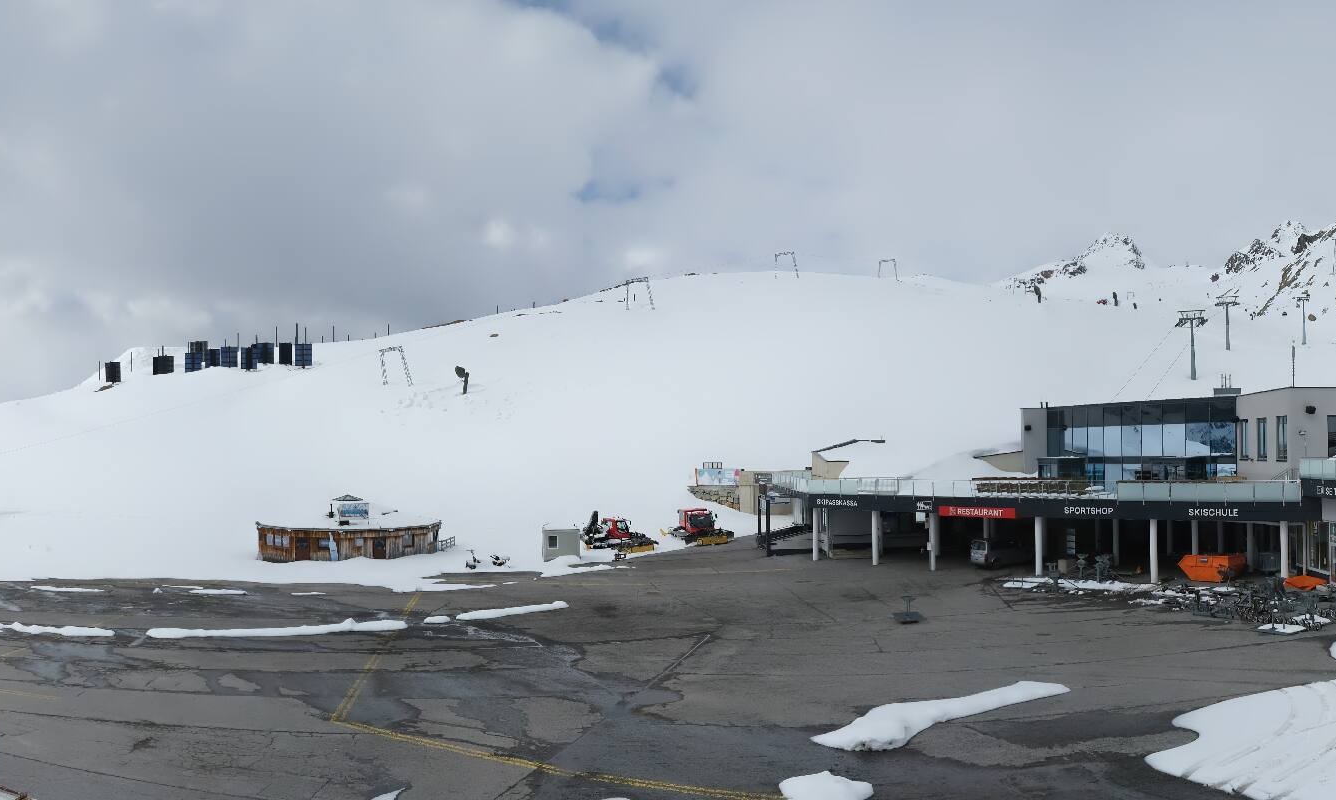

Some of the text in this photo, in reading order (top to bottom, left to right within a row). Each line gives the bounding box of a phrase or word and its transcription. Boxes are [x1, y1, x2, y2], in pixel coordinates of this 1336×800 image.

[957, 508, 1004, 517] RESTAURANT
[1064, 506, 1114, 515] SPORTSHOP
[1188, 508, 1239, 517] SKISCHULE
